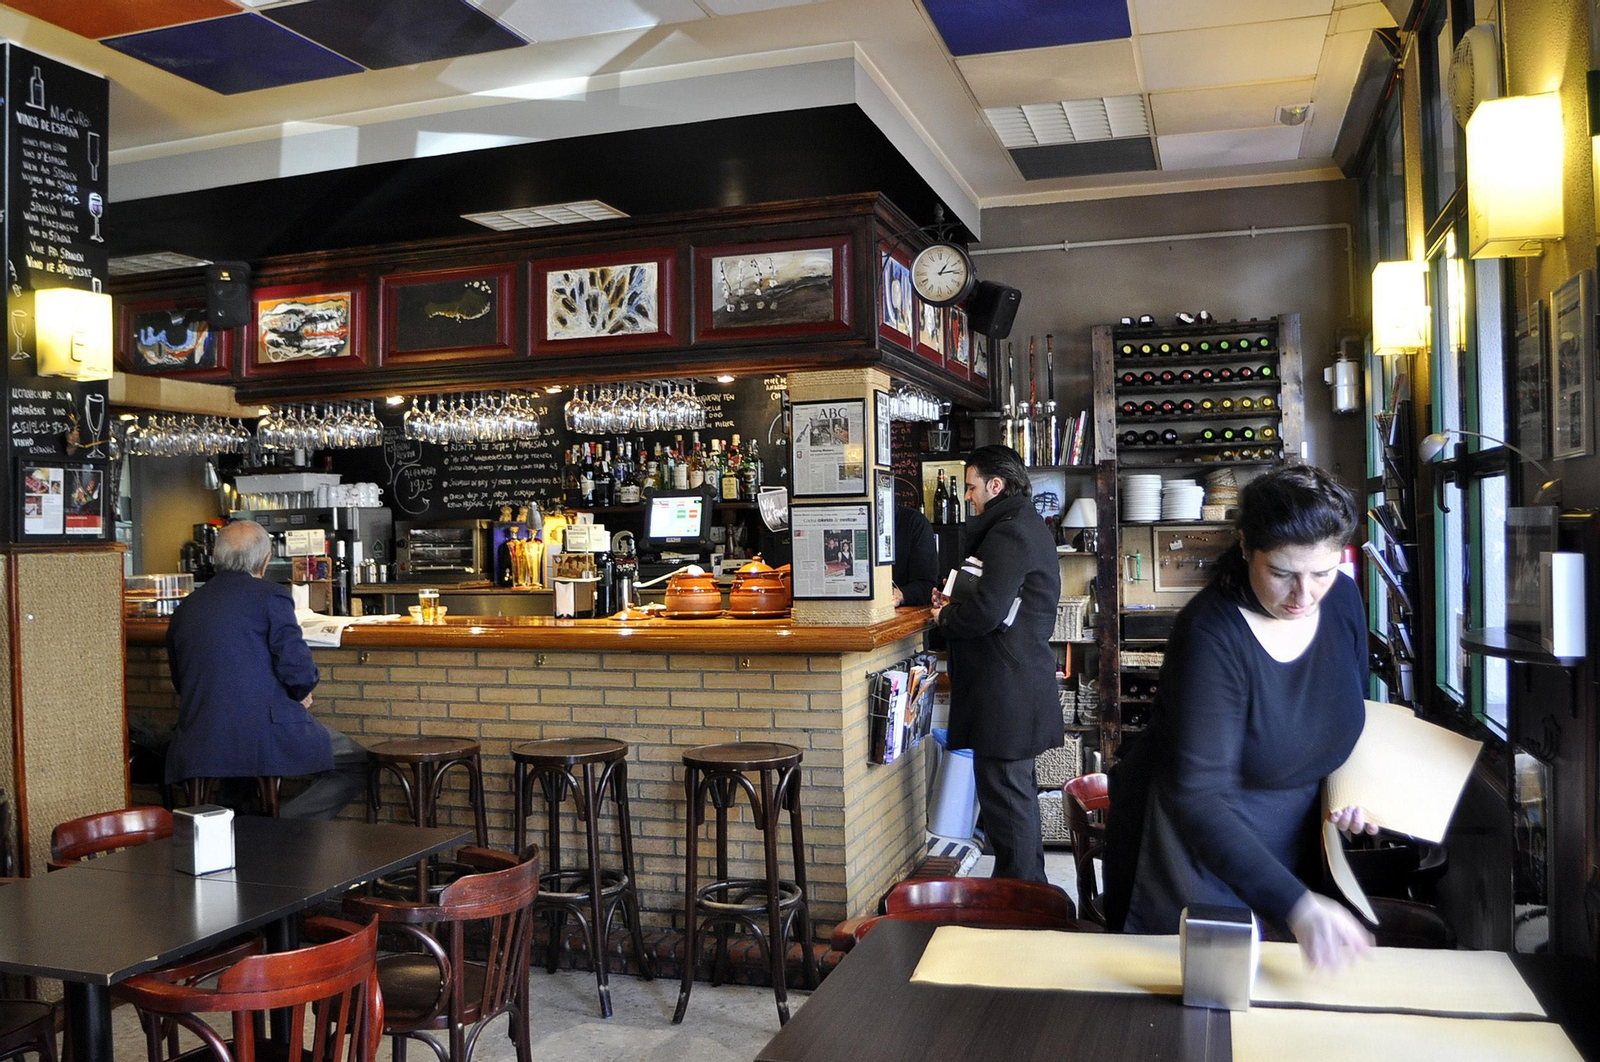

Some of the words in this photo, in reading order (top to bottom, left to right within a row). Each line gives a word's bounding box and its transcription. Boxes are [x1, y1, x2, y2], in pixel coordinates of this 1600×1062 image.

[16, 110, 39, 129] VINOS
[41, 119, 51, 132] DE
[819, 407, 848, 419] ABC
